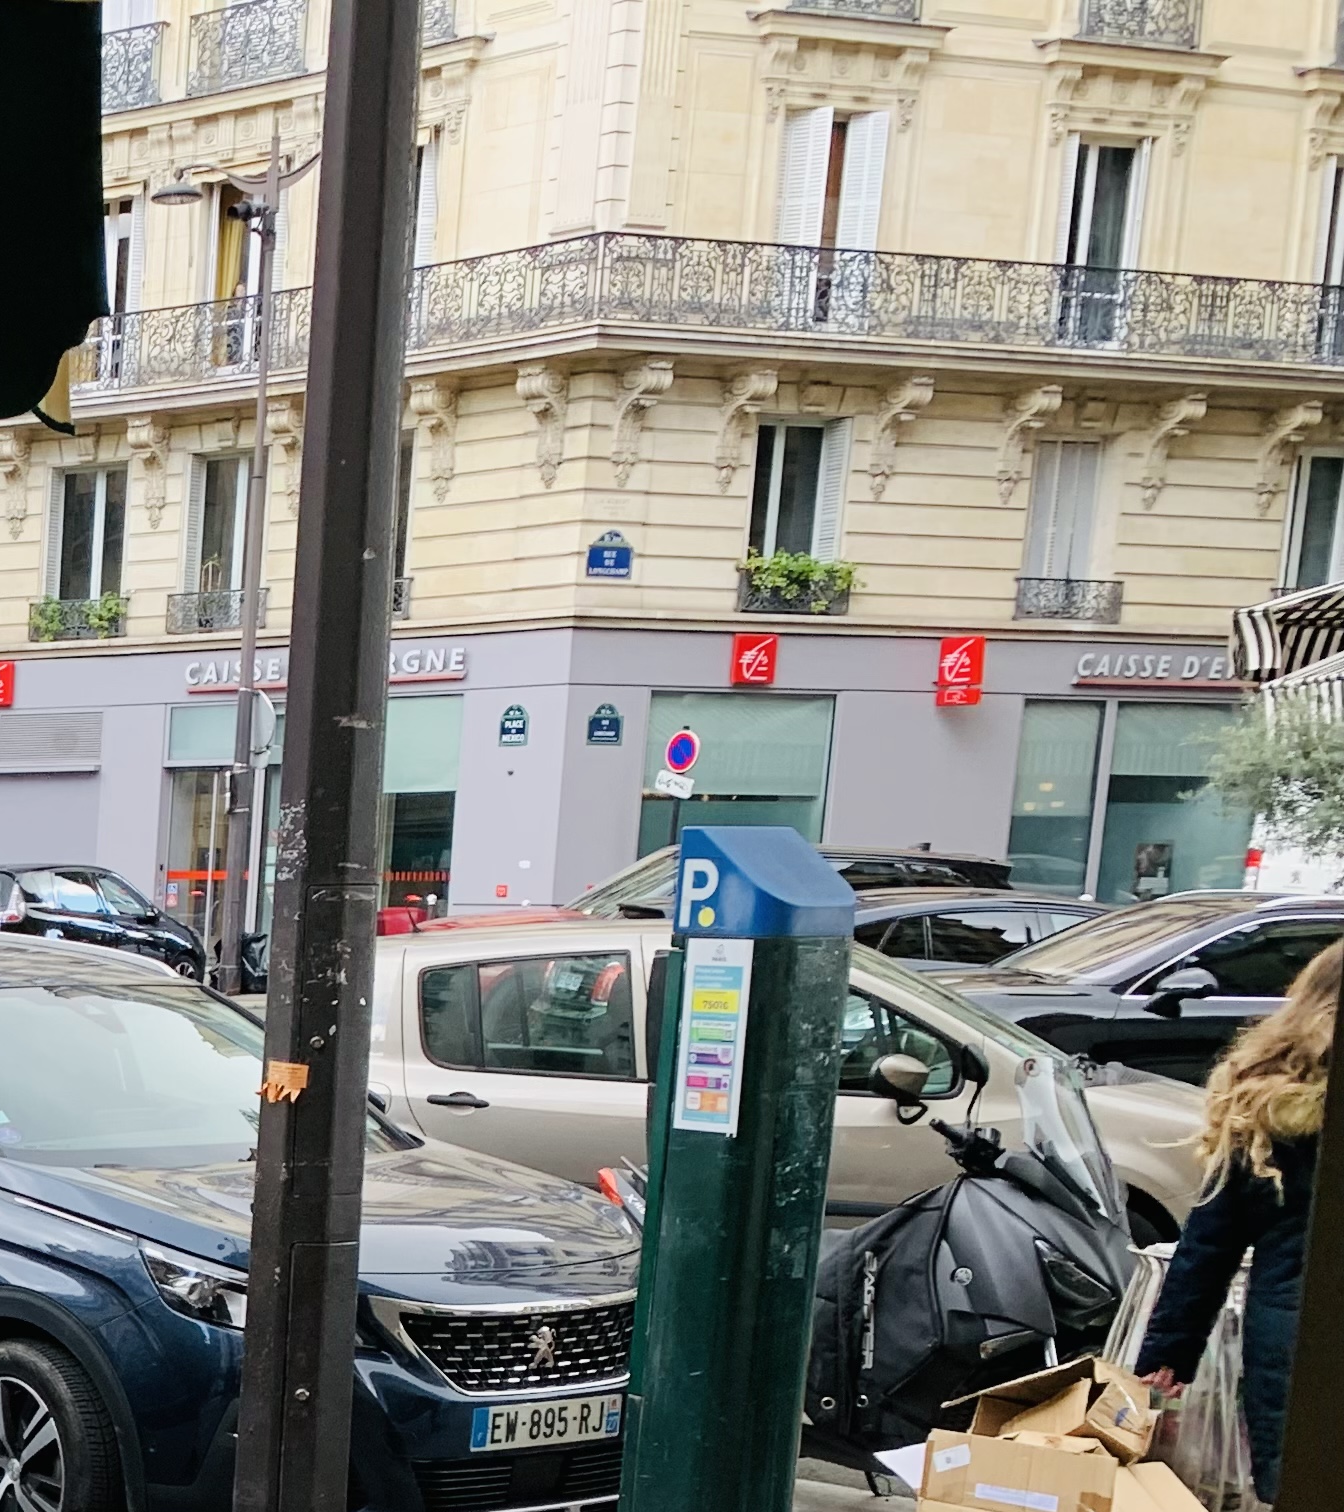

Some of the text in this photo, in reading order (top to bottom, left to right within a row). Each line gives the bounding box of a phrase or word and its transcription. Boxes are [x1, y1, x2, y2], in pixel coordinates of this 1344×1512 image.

[1077, 652, 1172, 678] CAISSE
[504, 719, 524, 728] PLACE
[501, 733, 525, 742] MEXICO
[678, 858, 720, 928] P
[490, 1401, 605, 1445] EW-895-RJ
